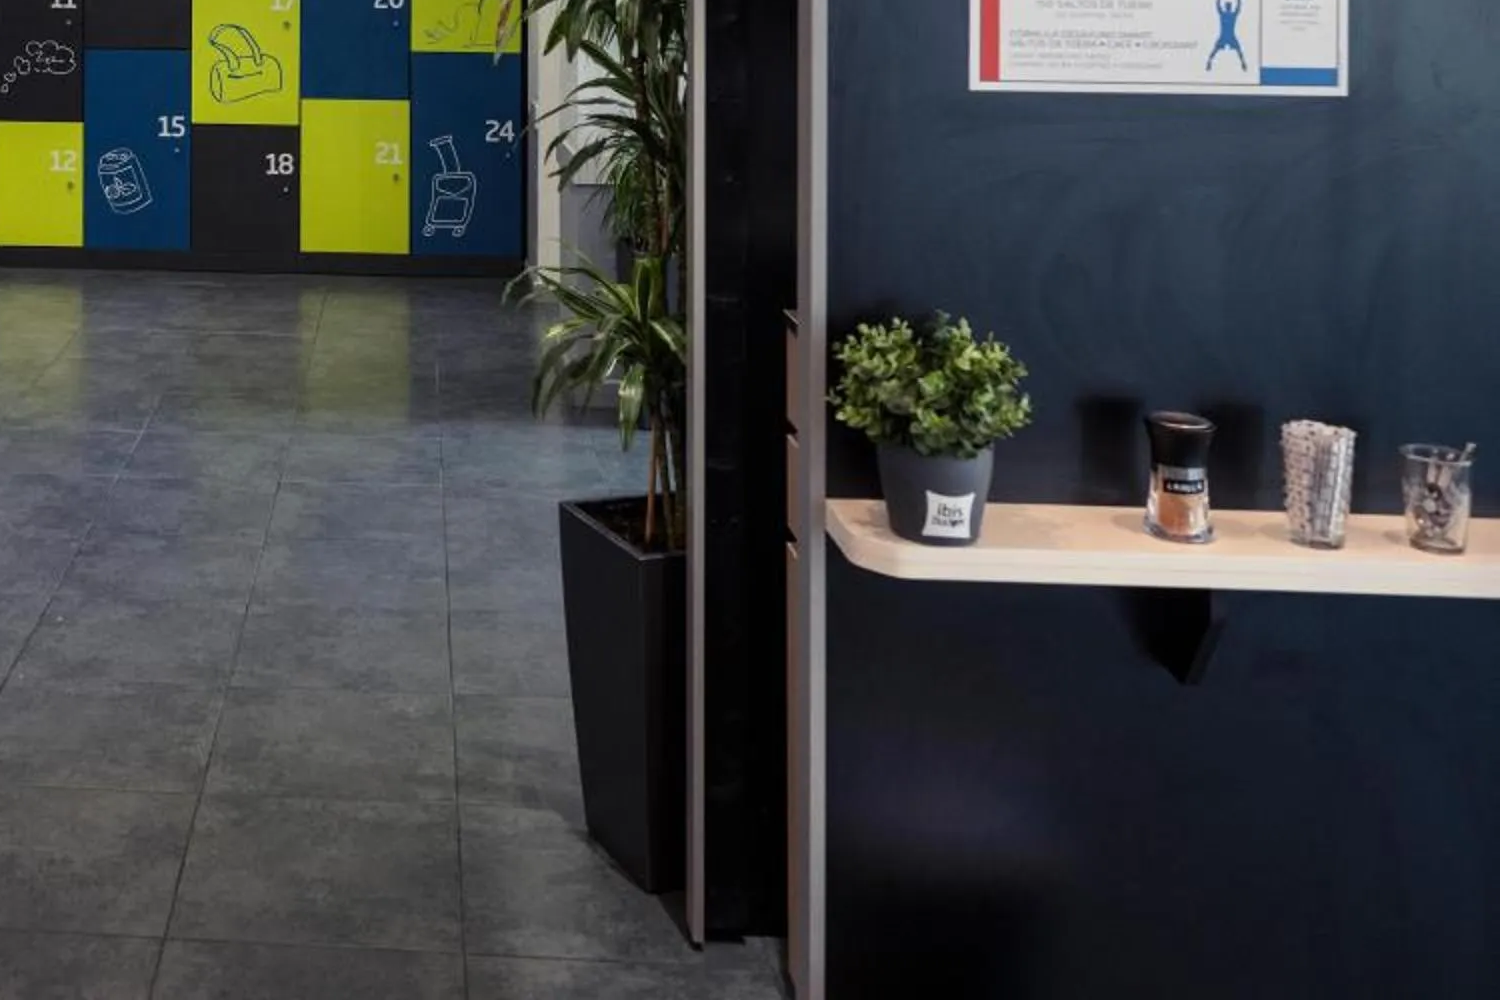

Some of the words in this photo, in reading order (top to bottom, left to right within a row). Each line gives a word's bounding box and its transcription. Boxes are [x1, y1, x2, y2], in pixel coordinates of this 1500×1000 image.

[158, 116, 186, 137] 15
[486, 120, 515, 142] 24
[51, 151, 77, 172] 12
[266, 154, 294, 175] 18
[376, 143, 403, 165] 21
